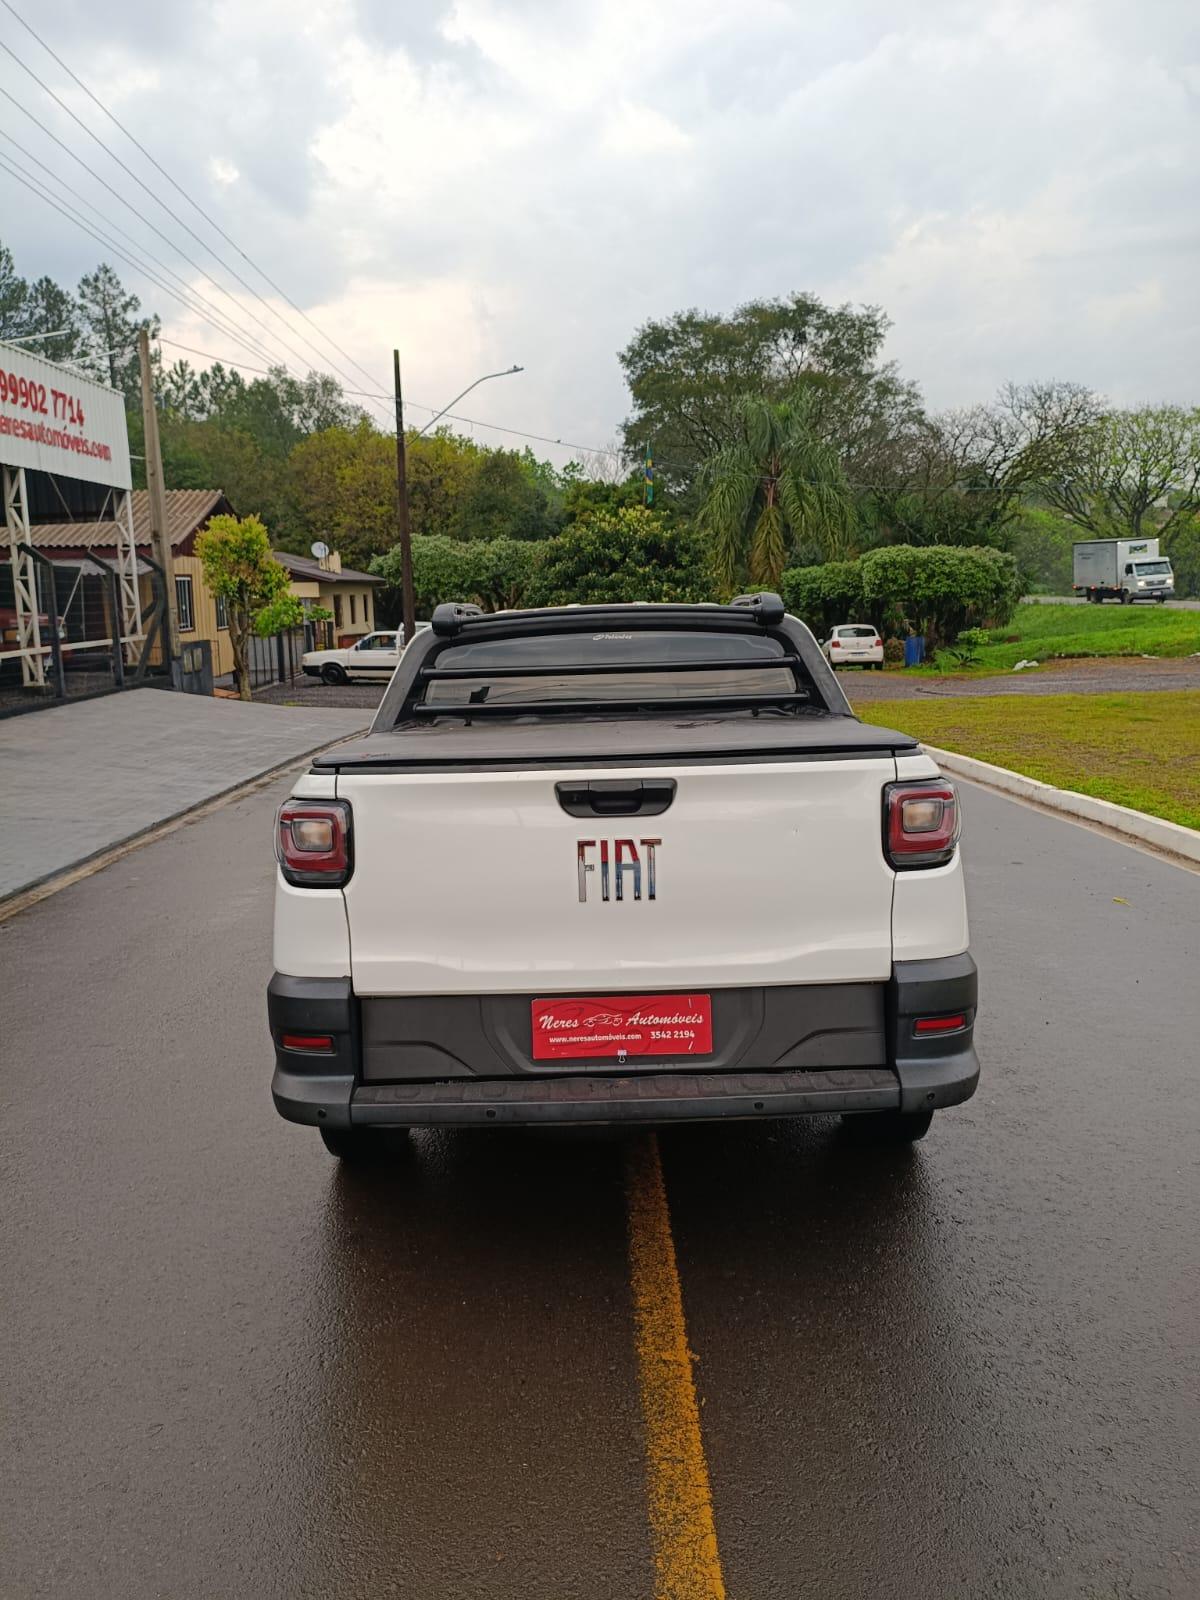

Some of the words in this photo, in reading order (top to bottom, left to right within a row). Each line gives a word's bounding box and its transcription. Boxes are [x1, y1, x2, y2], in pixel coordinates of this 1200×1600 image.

[50, 388, 85, 427] 7714
[577, 838, 662, 902] FIAT
[539, 1014, 580, 1029] Neres
[625, 1011, 704, 1026] Automóveis
[650, 1030, 672, 1039] 3542
[673, 1030, 695, 1039] 2194
